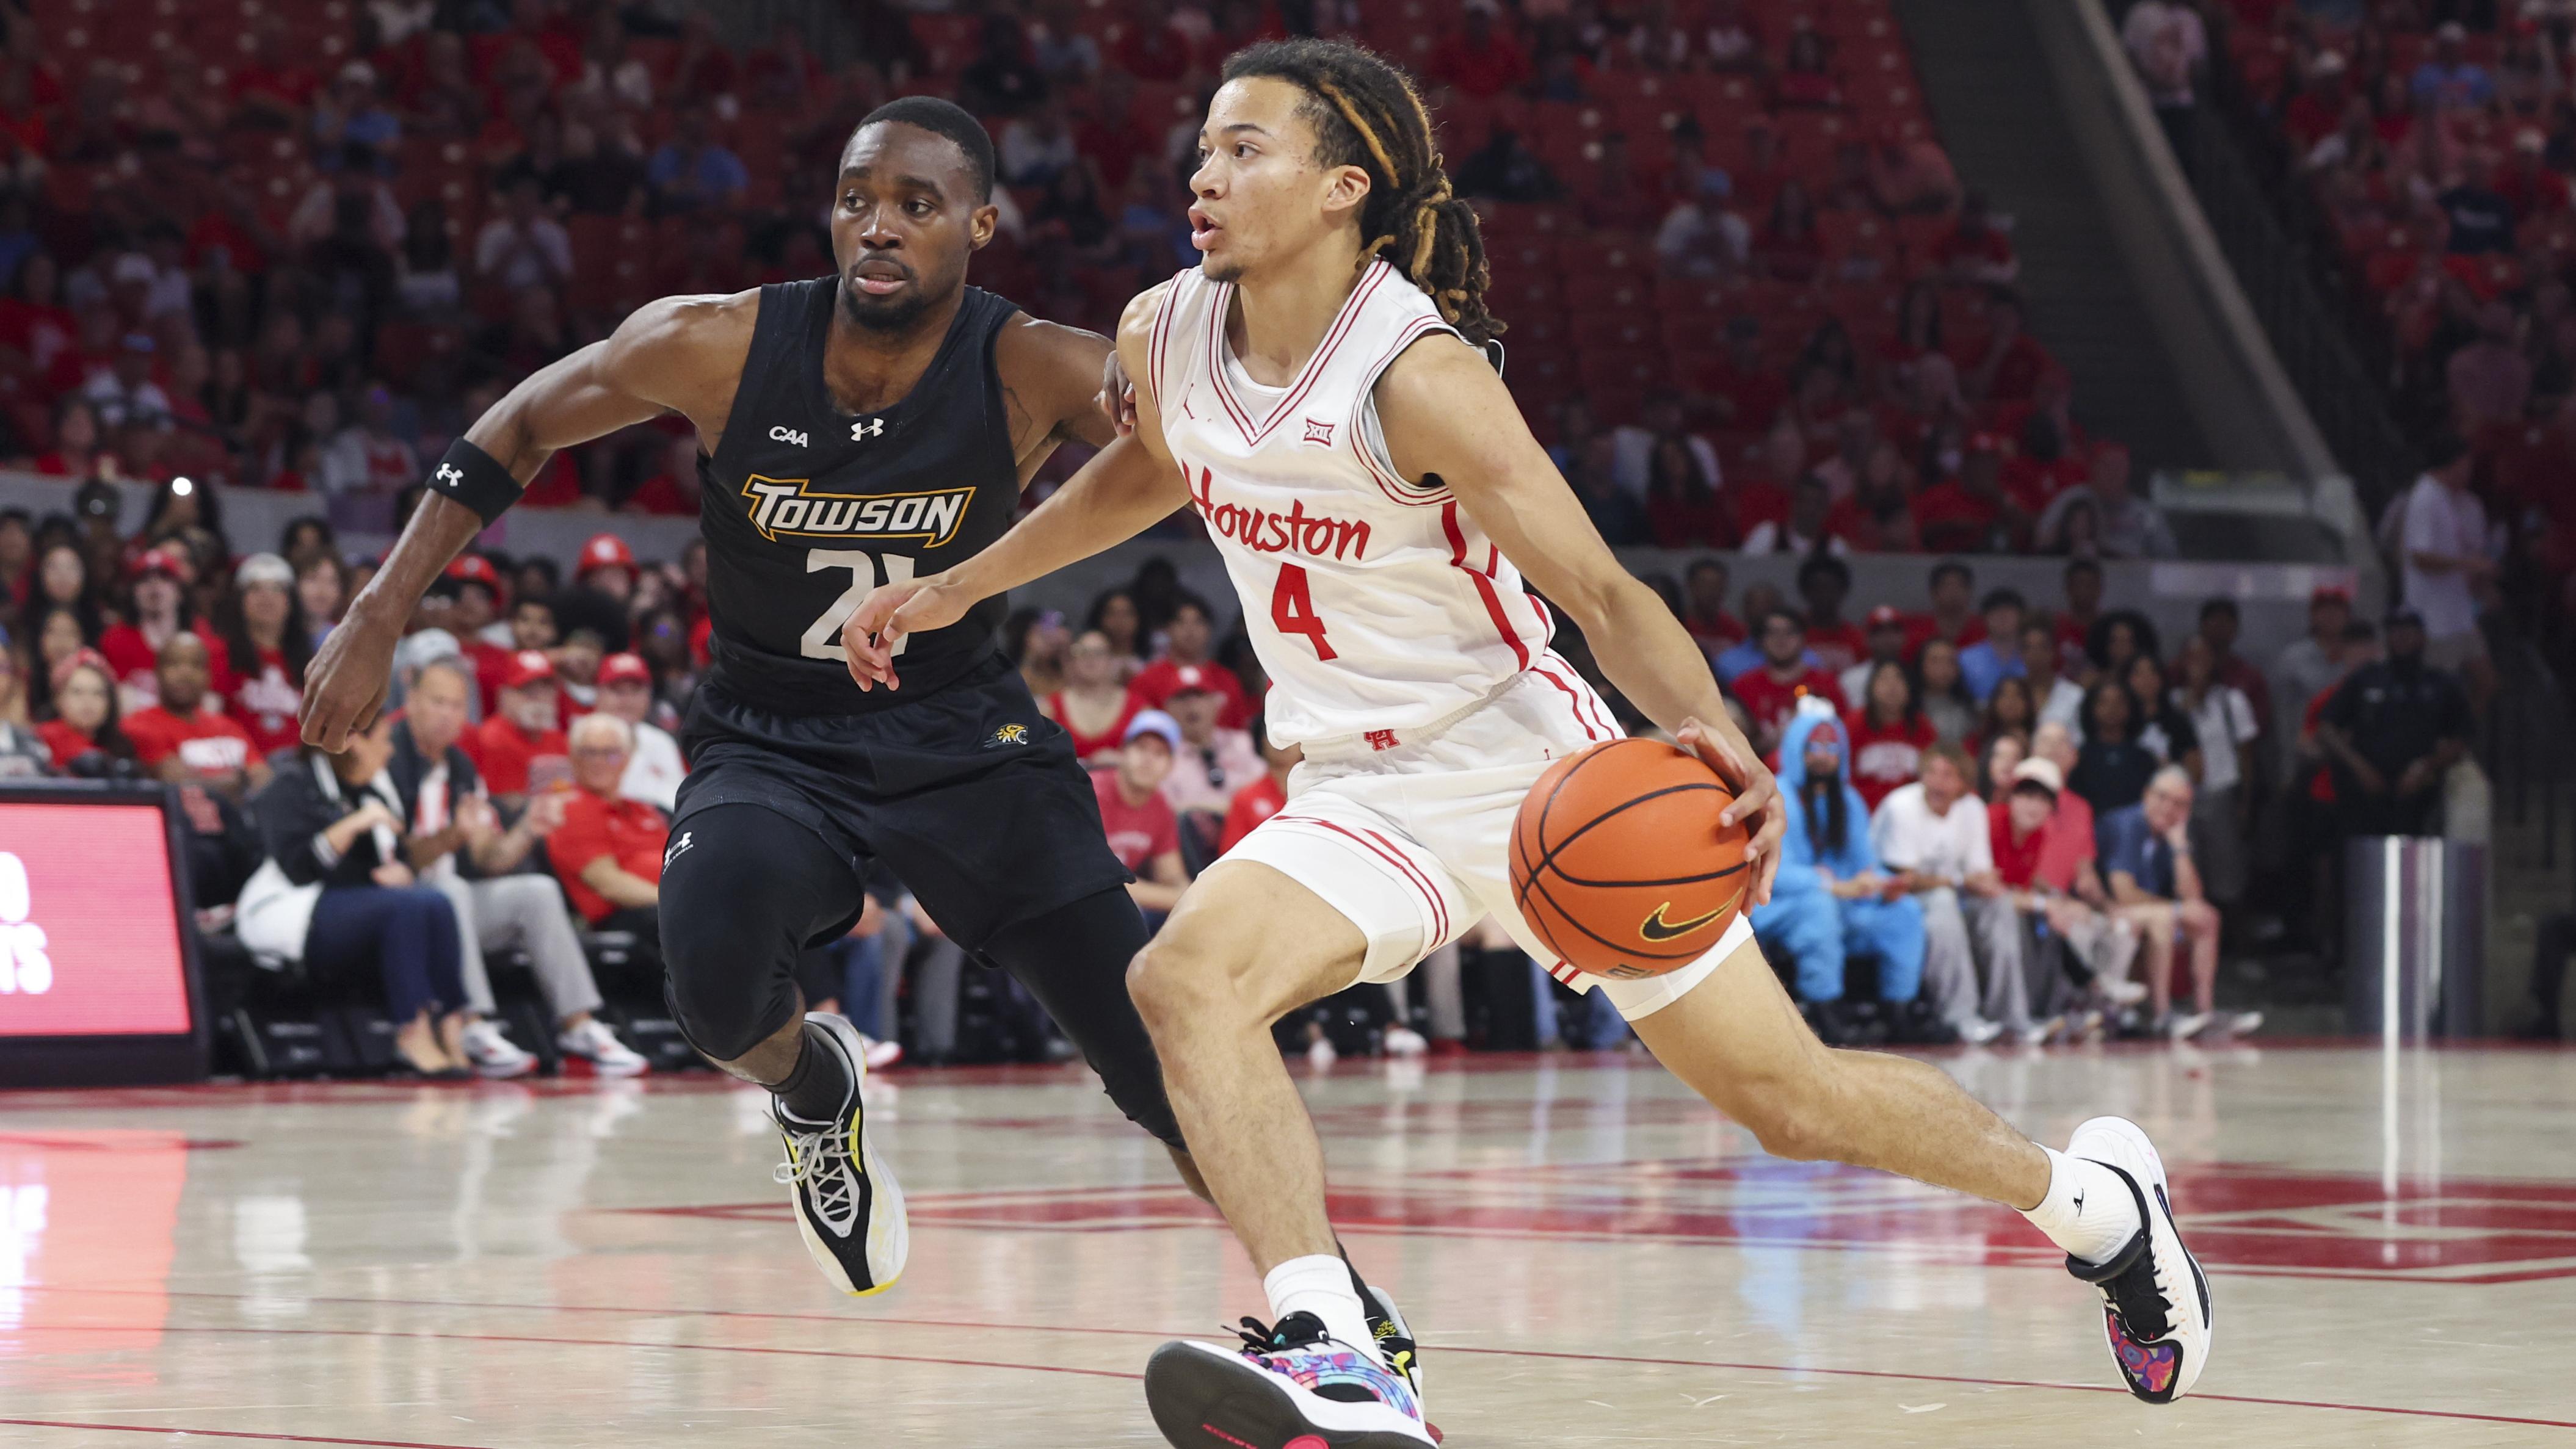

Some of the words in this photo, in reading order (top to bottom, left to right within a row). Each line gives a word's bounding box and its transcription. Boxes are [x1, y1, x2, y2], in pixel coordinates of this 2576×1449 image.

[769, 425, 808, 448] CAA
[751, 482, 964, 540] TOWSON
[1181, 458, 1371, 561] Houston
[1271, 562, 1338, 662] 4
